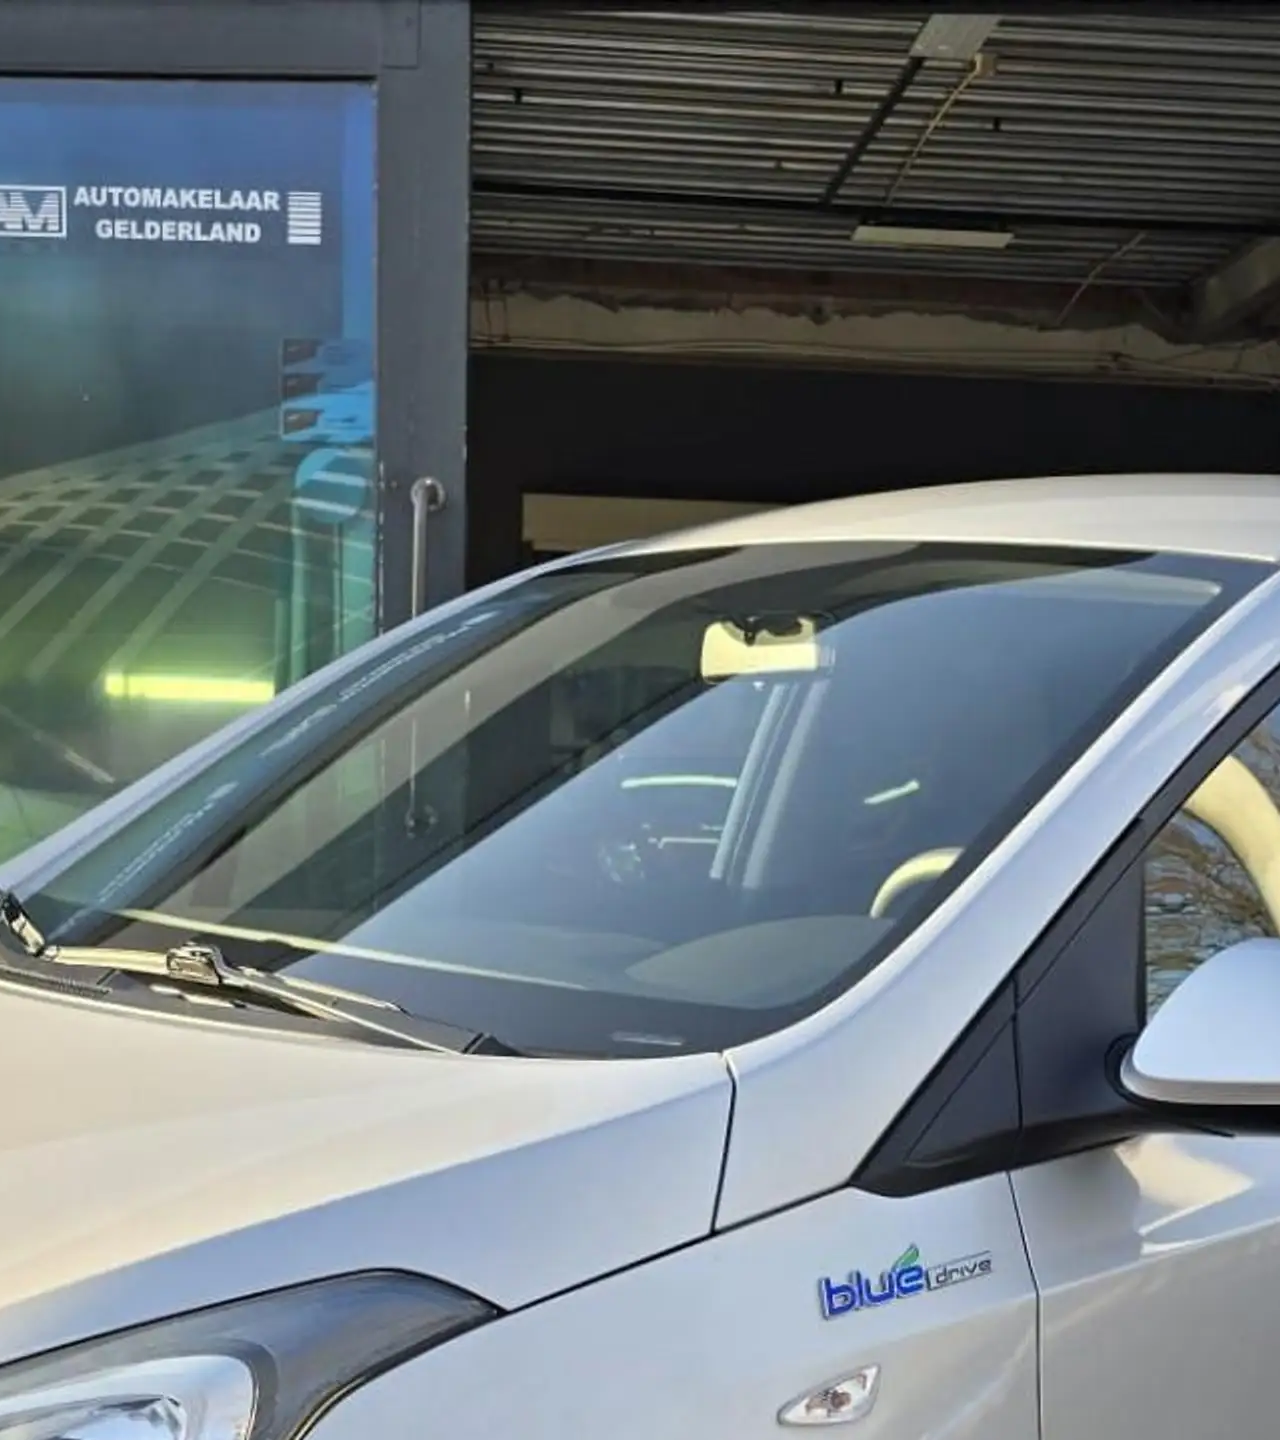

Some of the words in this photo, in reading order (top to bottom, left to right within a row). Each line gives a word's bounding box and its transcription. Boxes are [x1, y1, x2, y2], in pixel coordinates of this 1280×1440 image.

[73, 186, 280, 211] AUTOMAKELAAR
[94, 219, 262, 243] GELDERLAND
[819, 1262, 925, 1320] blue
[935, 1257, 993, 1285] drive
